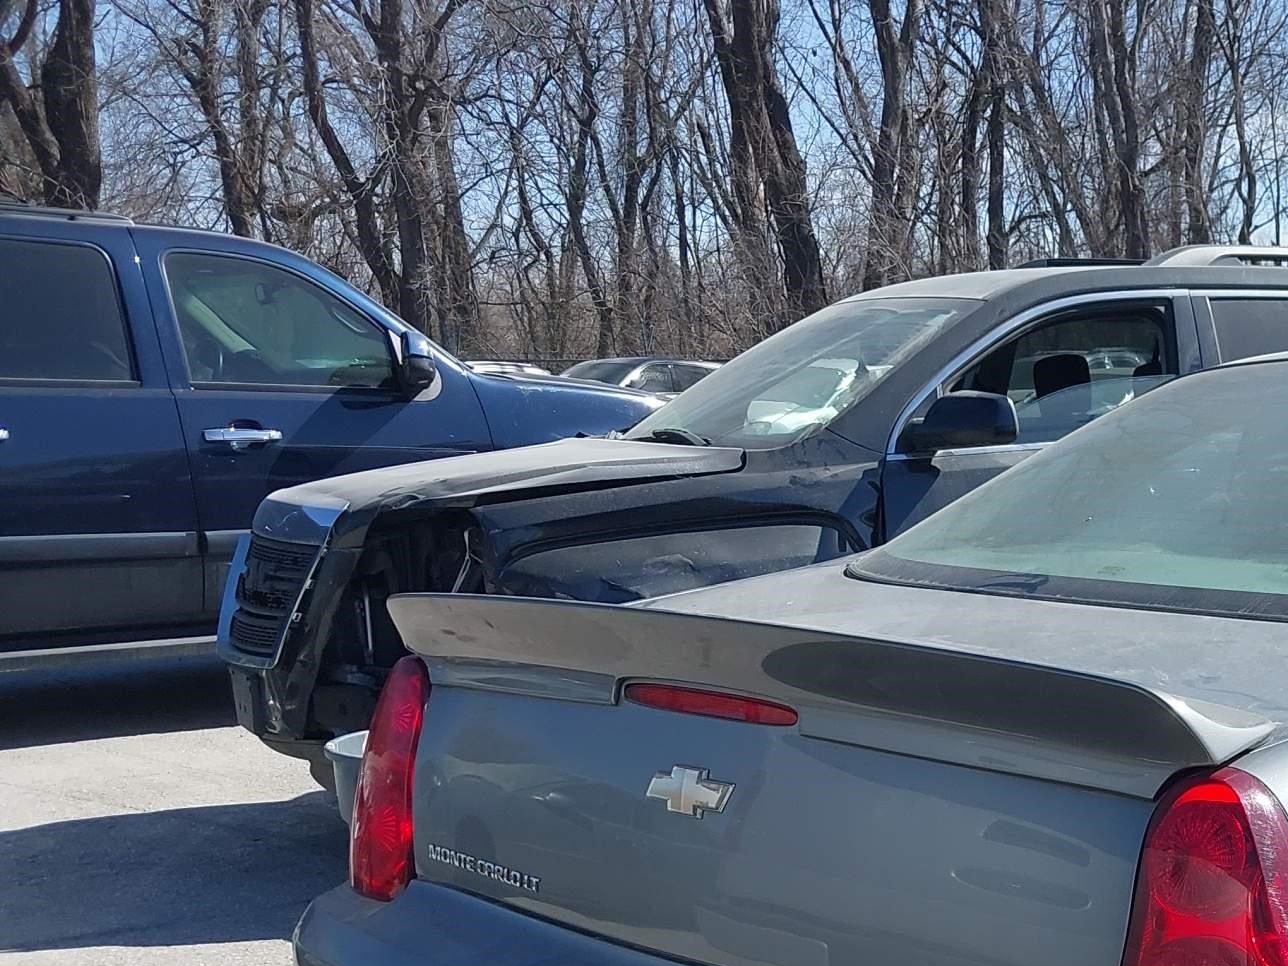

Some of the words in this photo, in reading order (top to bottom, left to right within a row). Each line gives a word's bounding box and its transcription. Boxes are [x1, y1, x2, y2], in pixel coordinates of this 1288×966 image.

[428, 844, 475, 872] MONTE
[477, 859, 521, 887] CARLO
[523, 874, 541, 893] LT
